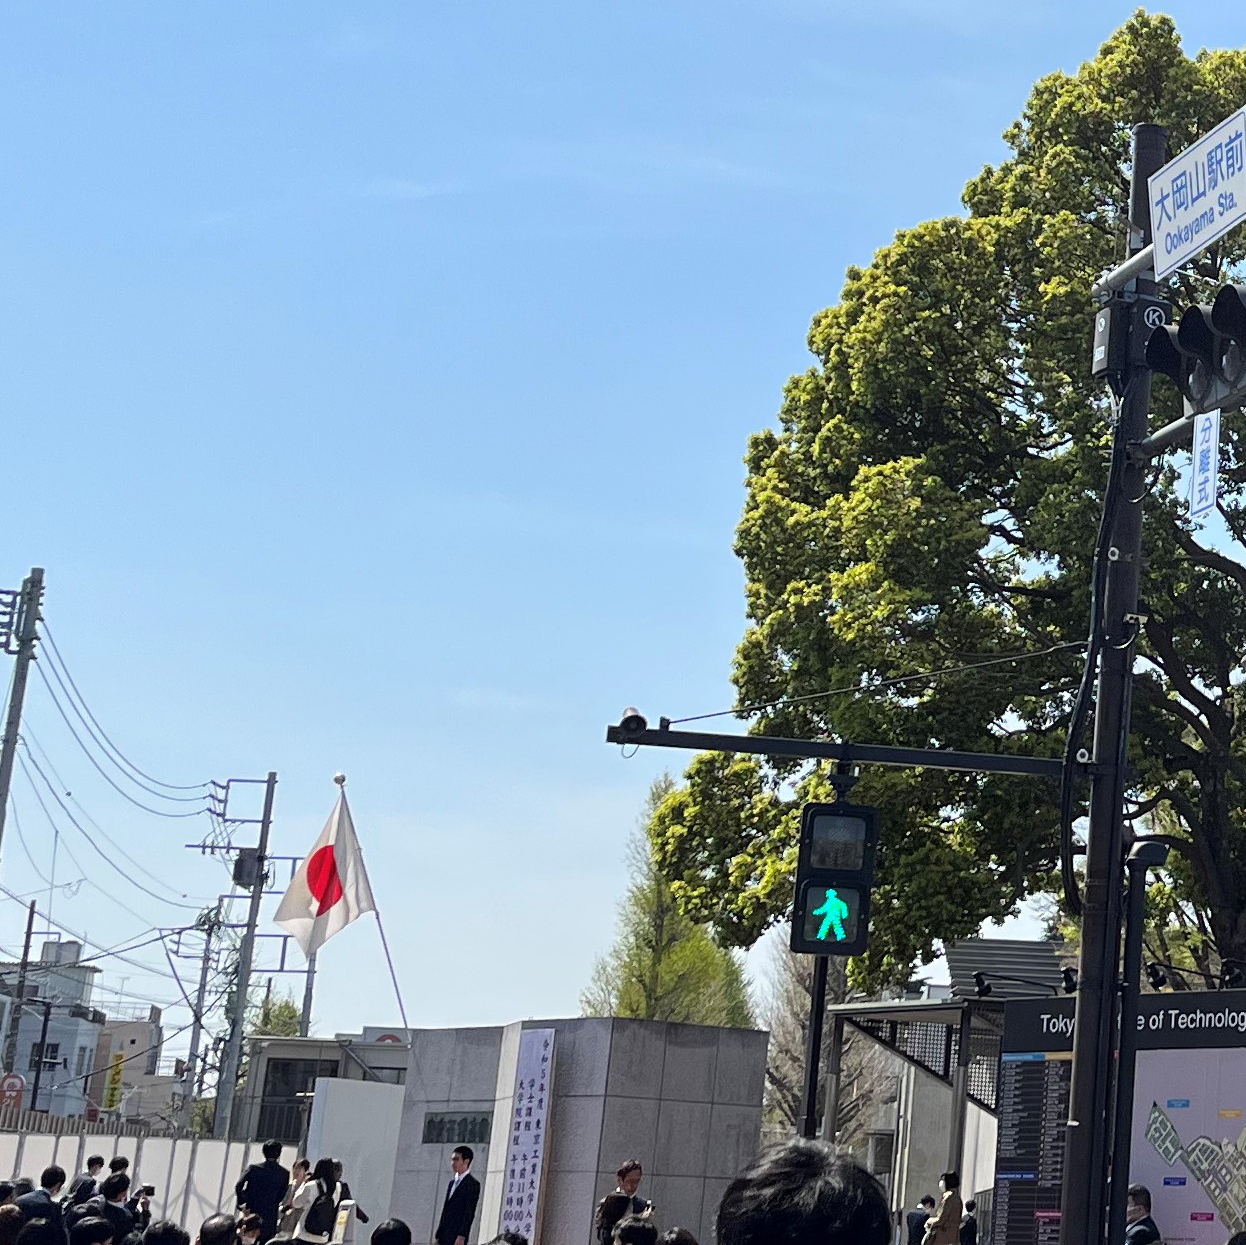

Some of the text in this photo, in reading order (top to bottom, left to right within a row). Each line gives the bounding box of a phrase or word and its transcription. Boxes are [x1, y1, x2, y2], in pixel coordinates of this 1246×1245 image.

[1155, 130, 1243, 231] 大岡山駅前
[1165, 191, 1238, 255] Ookayama Sta.
[1040, 1013, 1076, 1037] Toky
[1149, 1010, 1165, 1030] of
